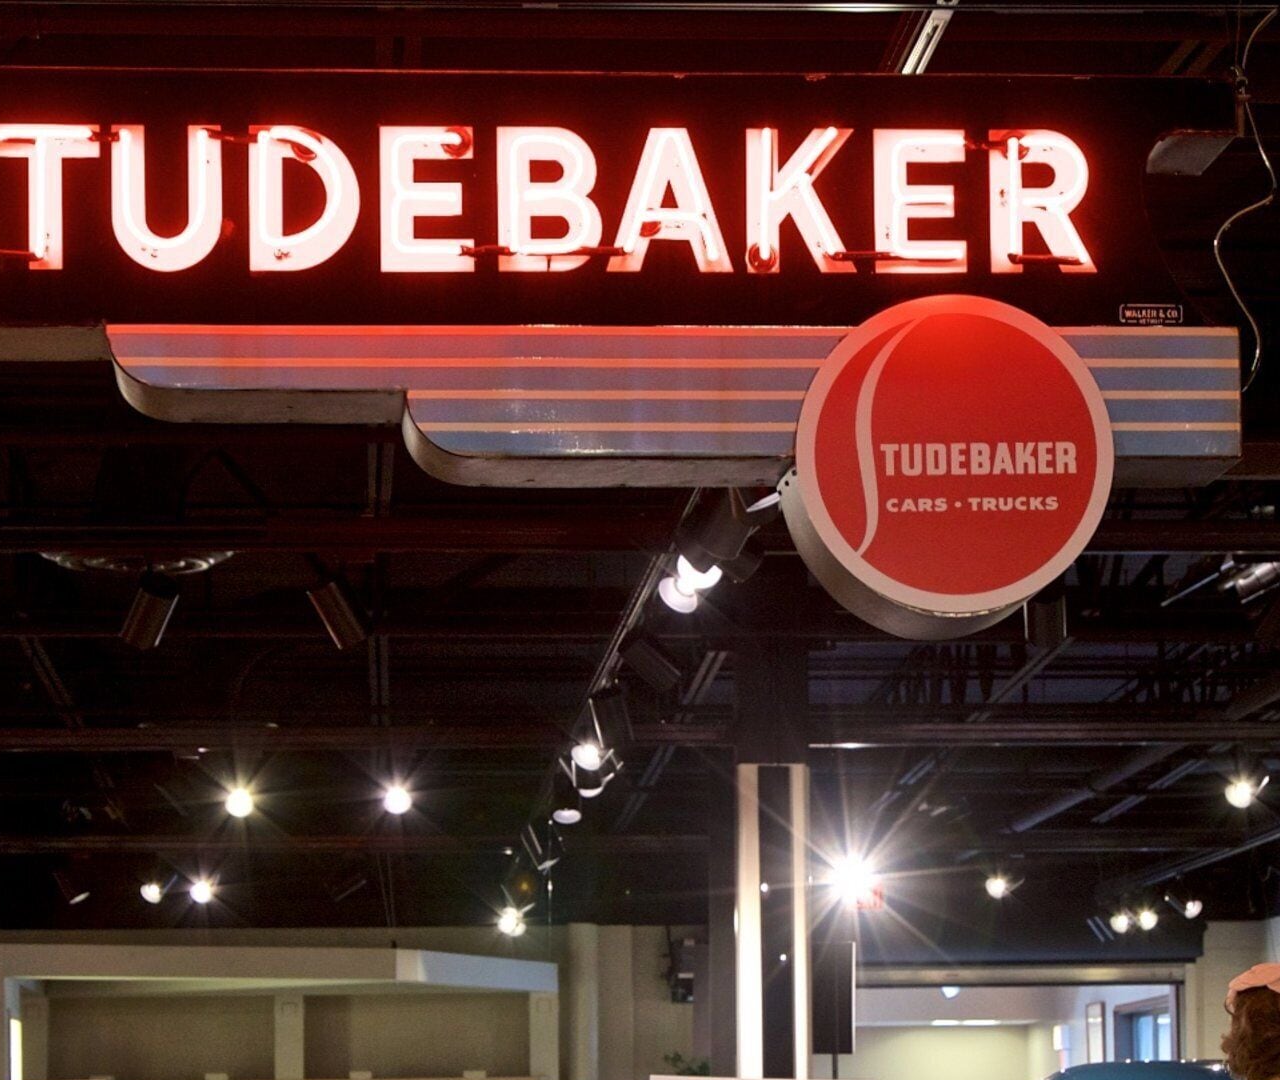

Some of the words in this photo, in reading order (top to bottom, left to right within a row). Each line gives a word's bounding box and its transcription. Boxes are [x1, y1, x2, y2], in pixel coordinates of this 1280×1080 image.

[1124, 309, 1157, 318] WALKER
[1159, 309, 1165, 318] &
[886, 498, 948, 512] CARS
[968, 497, 1059, 511] TRUCKS
